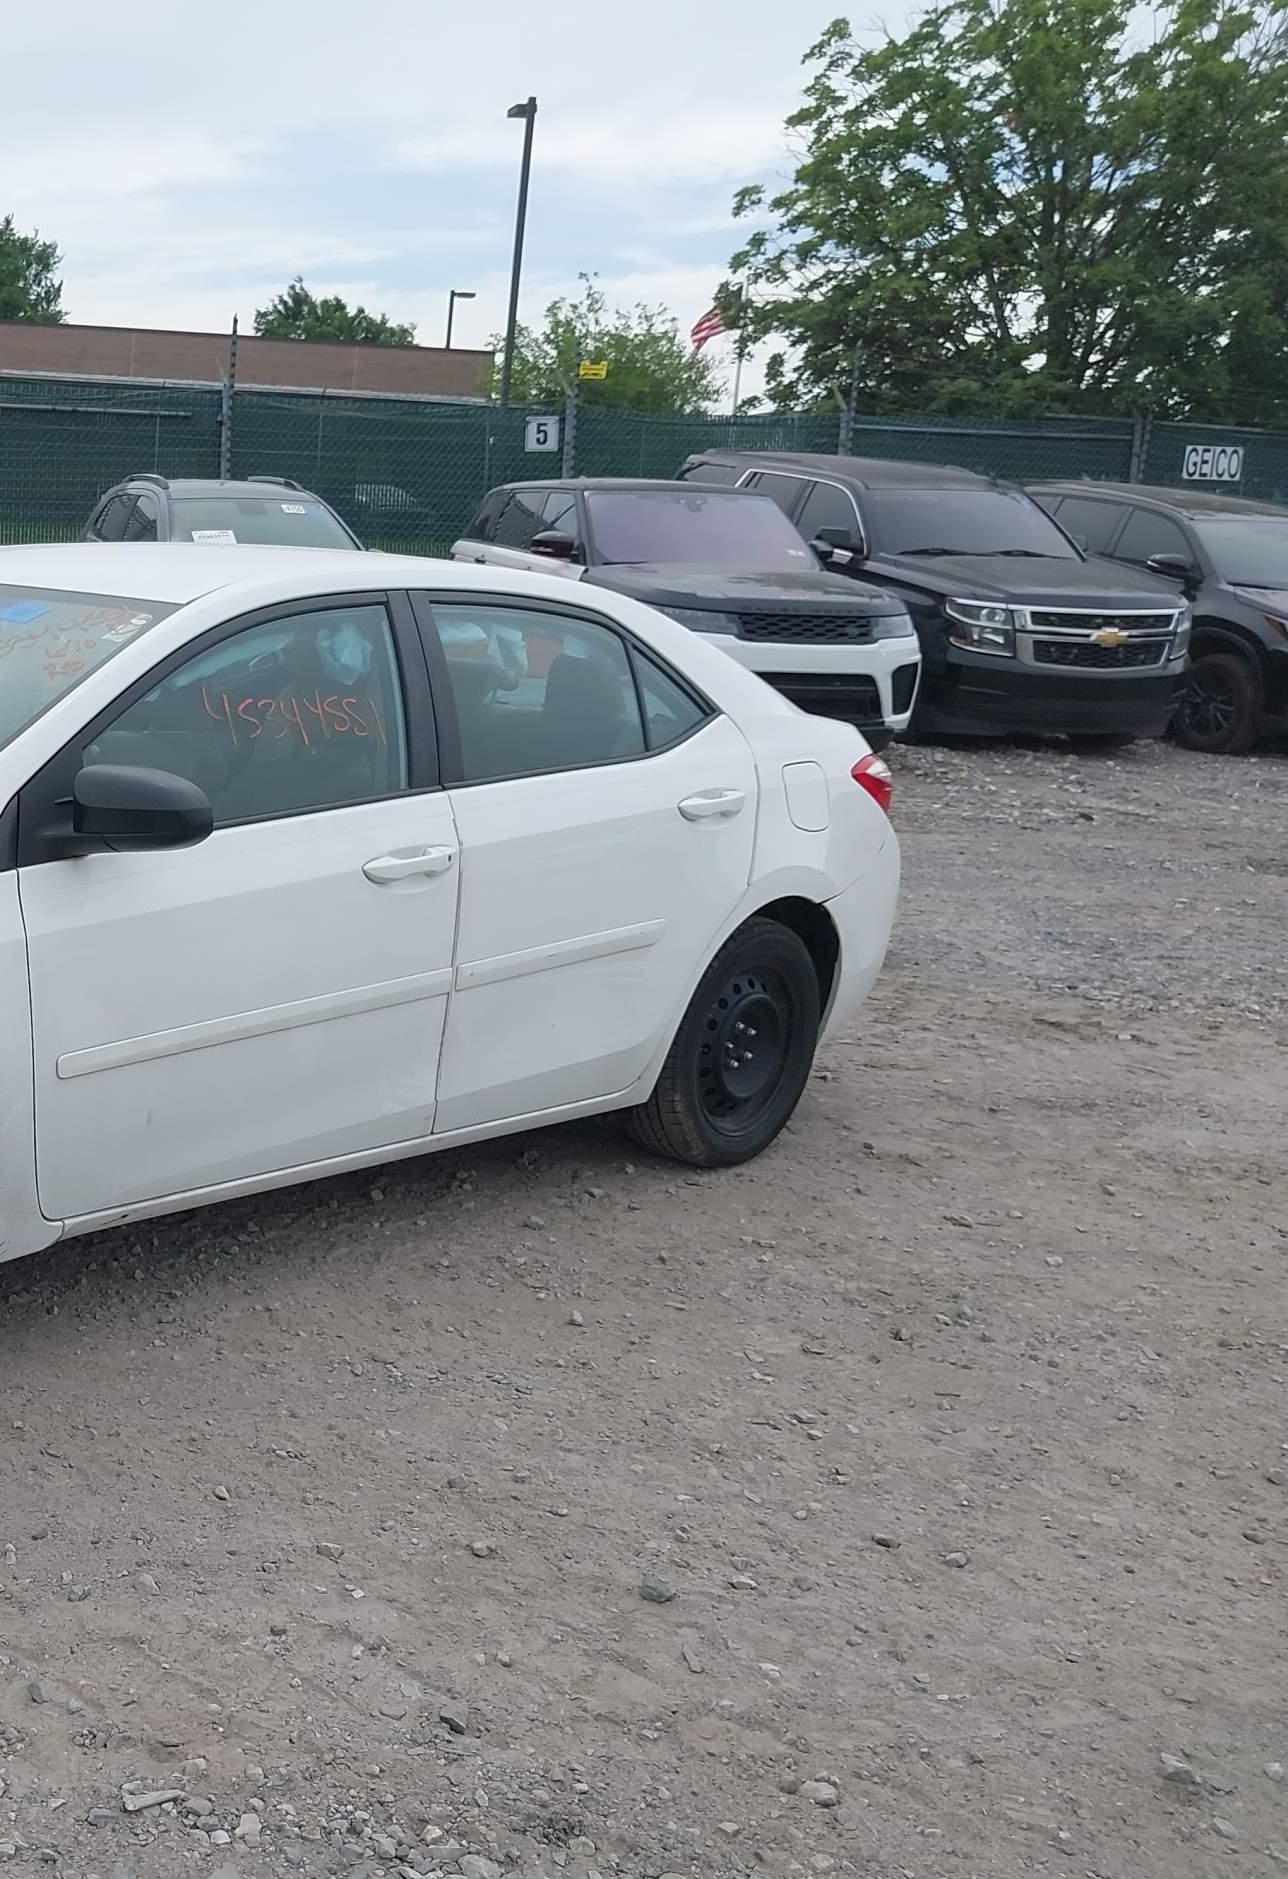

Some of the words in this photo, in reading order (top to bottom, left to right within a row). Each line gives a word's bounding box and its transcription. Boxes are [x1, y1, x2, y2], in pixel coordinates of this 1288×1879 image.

[536, 422, 548, 445] 5
[1186, 447, 1240, 478] GEICO
[201, 687, 388, 747] 45344551
